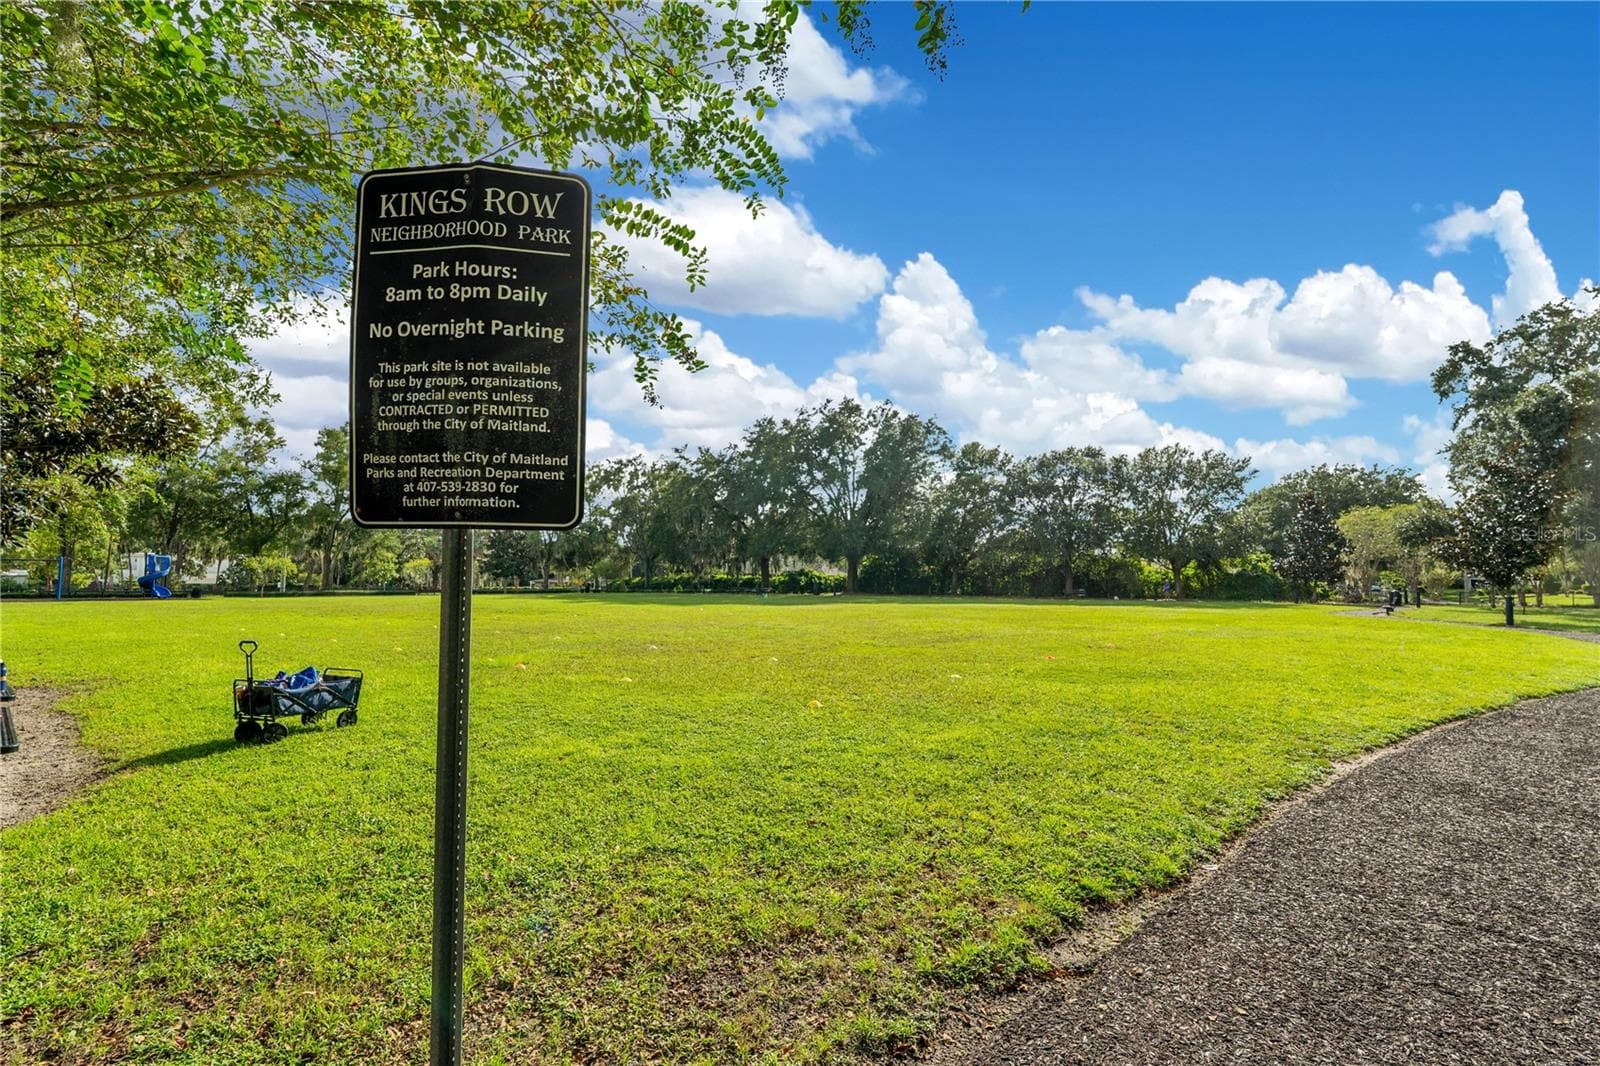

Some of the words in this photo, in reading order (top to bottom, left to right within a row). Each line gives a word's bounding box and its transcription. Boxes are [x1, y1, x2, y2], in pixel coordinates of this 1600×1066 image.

[380, 189, 466, 217] KINGS
[484, 188, 563, 219] ROW
[371, 220, 506, 242] NEIGHBORHOOD
[519, 226, 571, 244] PARK
[413, 262, 449, 278] Park
[456, 261, 516, 279] Hours:
[386, 287, 421, 301] 8am
[427, 286, 444, 299] to
[450, 284, 490, 301] 8pm
[498, 285, 547, 306] Daily
[370, 323, 392, 338] No
[398, 318, 484, 338] Overnight
[492, 320, 564, 343] Parking
[379, 363, 400, 373] This
[404, 361, 428, 374] park
[432, 362, 451, 371] site
[455, 360, 463, 370] is
[468, 362, 489, 370] not
[493, 362, 550, 374] available
[369, 377, 384, 387] for
[388, 379, 405, 387] use
[409, 376, 422, 388] by
[425, 377, 467, 388] groups,
[472, 376, 561, 391] organizations,
[407, 389, 444, 403] special
[448, 391, 488, 400] events
[493, 391, 533, 402] unless
[379, 404, 453, 416] CONTRACTED
[457, 406, 469, 414] or
[474, 404, 549, 417] PERMITTED
[378, 419, 419, 432] through
[423, 419, 441, 429] the
[445, 418, 466, 431] City
[471, 418, 484, 429] of
[488, 420, 550, 432] Maitland.
[364, 454, 396, 463] Please
[400, 453, 439, 463] contact
[443, 451, 460, 462] the
[464, 452, 488, 465] City
[493, 453, 507, 463] of
[511, 454, 568, 465] Maitland
[367, 468, 394, 478] Parks
[398, 467, 416, 477] and
[421, 466, 480, 477] Recreation
[486, 468, 564, 480] Department
[404, 483, 413, 492] at
[417, 481, 496, 492] 407-539-2830
[500, 482, 518, 493] for
[403, 496, 440, 506] further
[444, 496, 519, 507] information.
